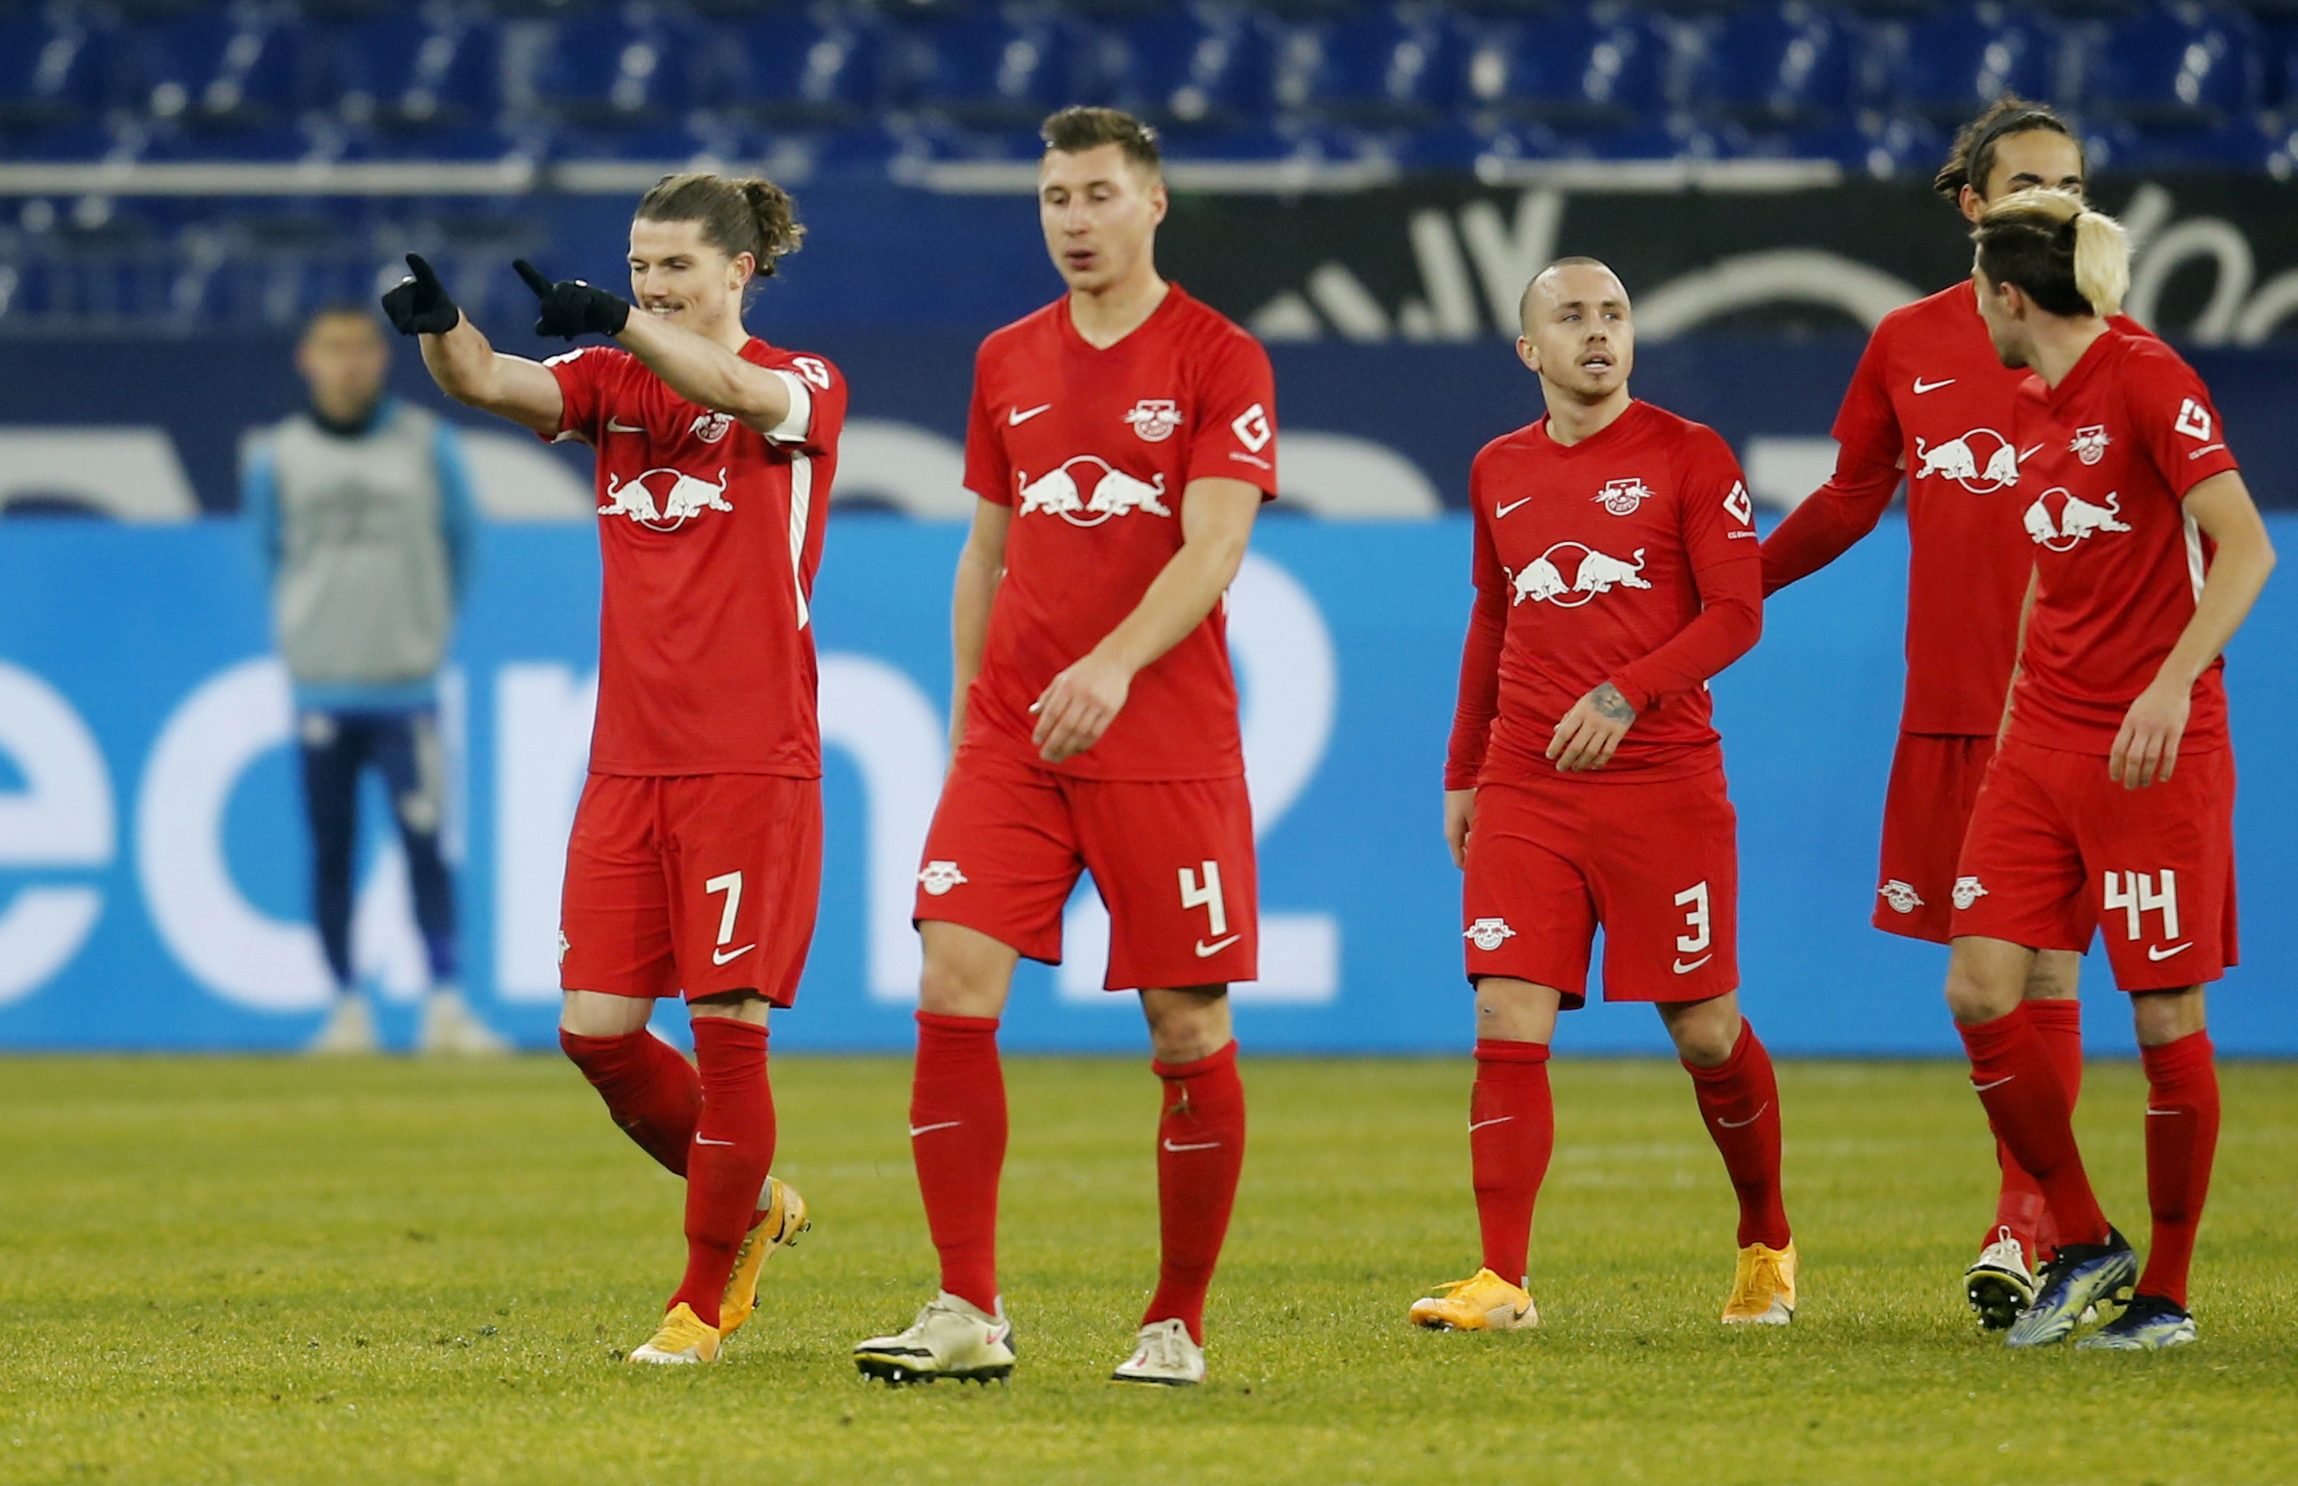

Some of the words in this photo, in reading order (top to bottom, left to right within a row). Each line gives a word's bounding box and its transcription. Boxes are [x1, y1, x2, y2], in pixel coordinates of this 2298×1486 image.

[705, 870, 743, 946] 7
[1178, 860, 1228, 937] 4
[1674, 880, 1711, 953] 3
[2104, 868, 2181, 941] 44
